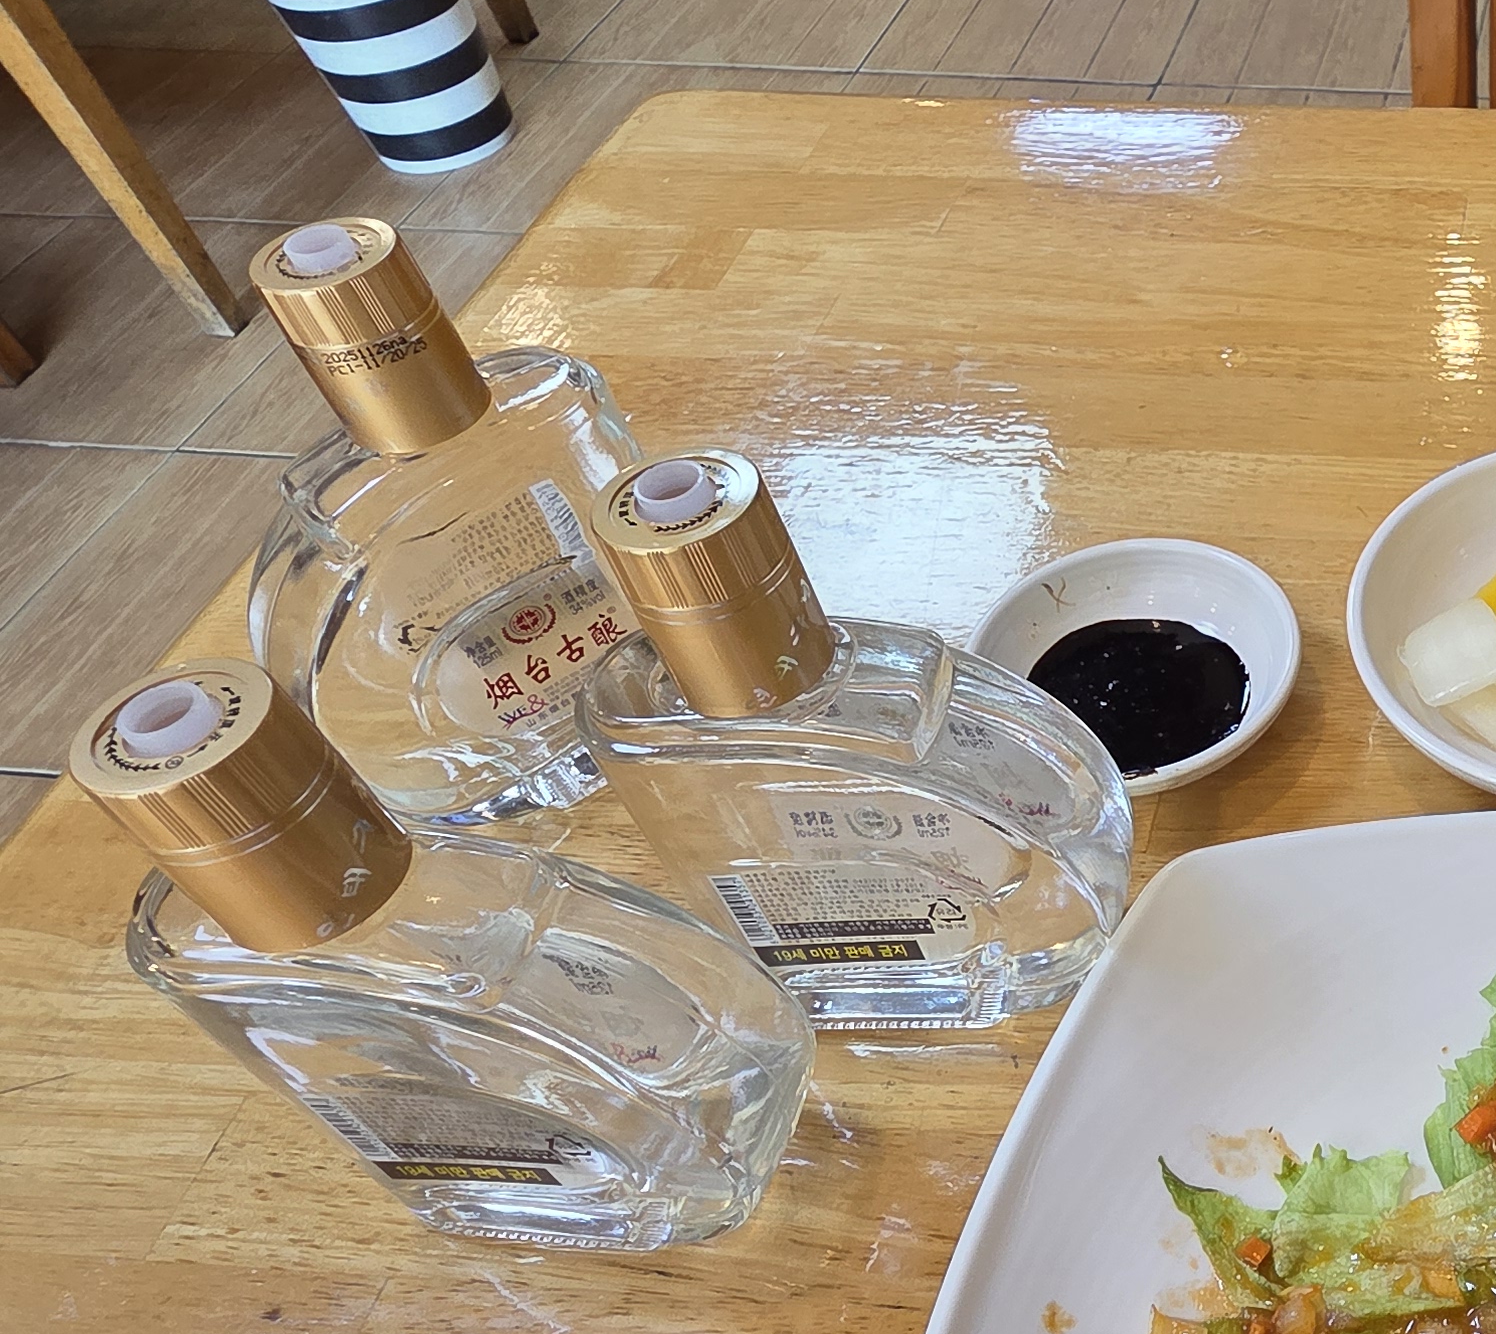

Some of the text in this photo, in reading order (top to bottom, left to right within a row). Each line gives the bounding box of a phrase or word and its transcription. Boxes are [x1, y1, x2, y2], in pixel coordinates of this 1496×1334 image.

[473, 646, 503, 669] 125ml
[483, 613, 628, 710] 烟台古酿
[773, 943, 909, 962] 19세 미만 판매 금지
